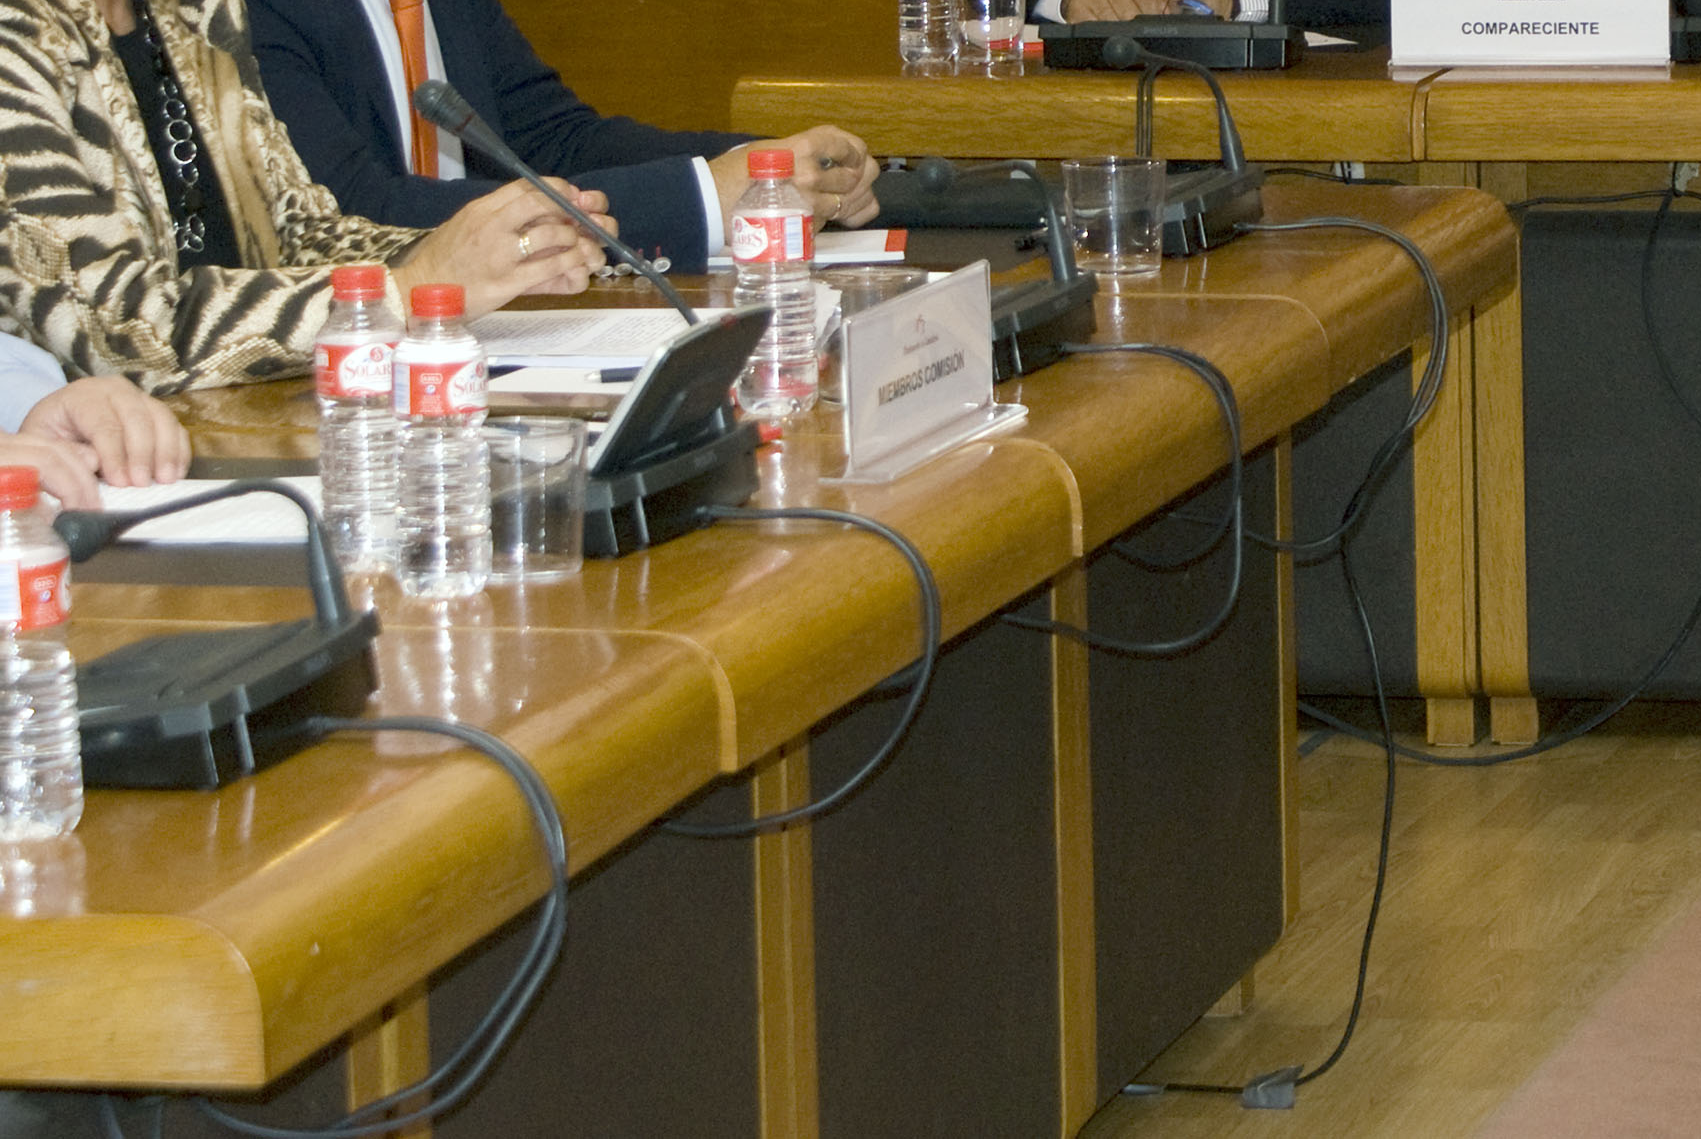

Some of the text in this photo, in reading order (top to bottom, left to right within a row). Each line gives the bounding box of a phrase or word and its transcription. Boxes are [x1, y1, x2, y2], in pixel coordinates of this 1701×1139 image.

[1461, 21, 1600, 35] COMPARECIENTE
[878, 348, 965, 407] MIEMBROS COMISIÓN
